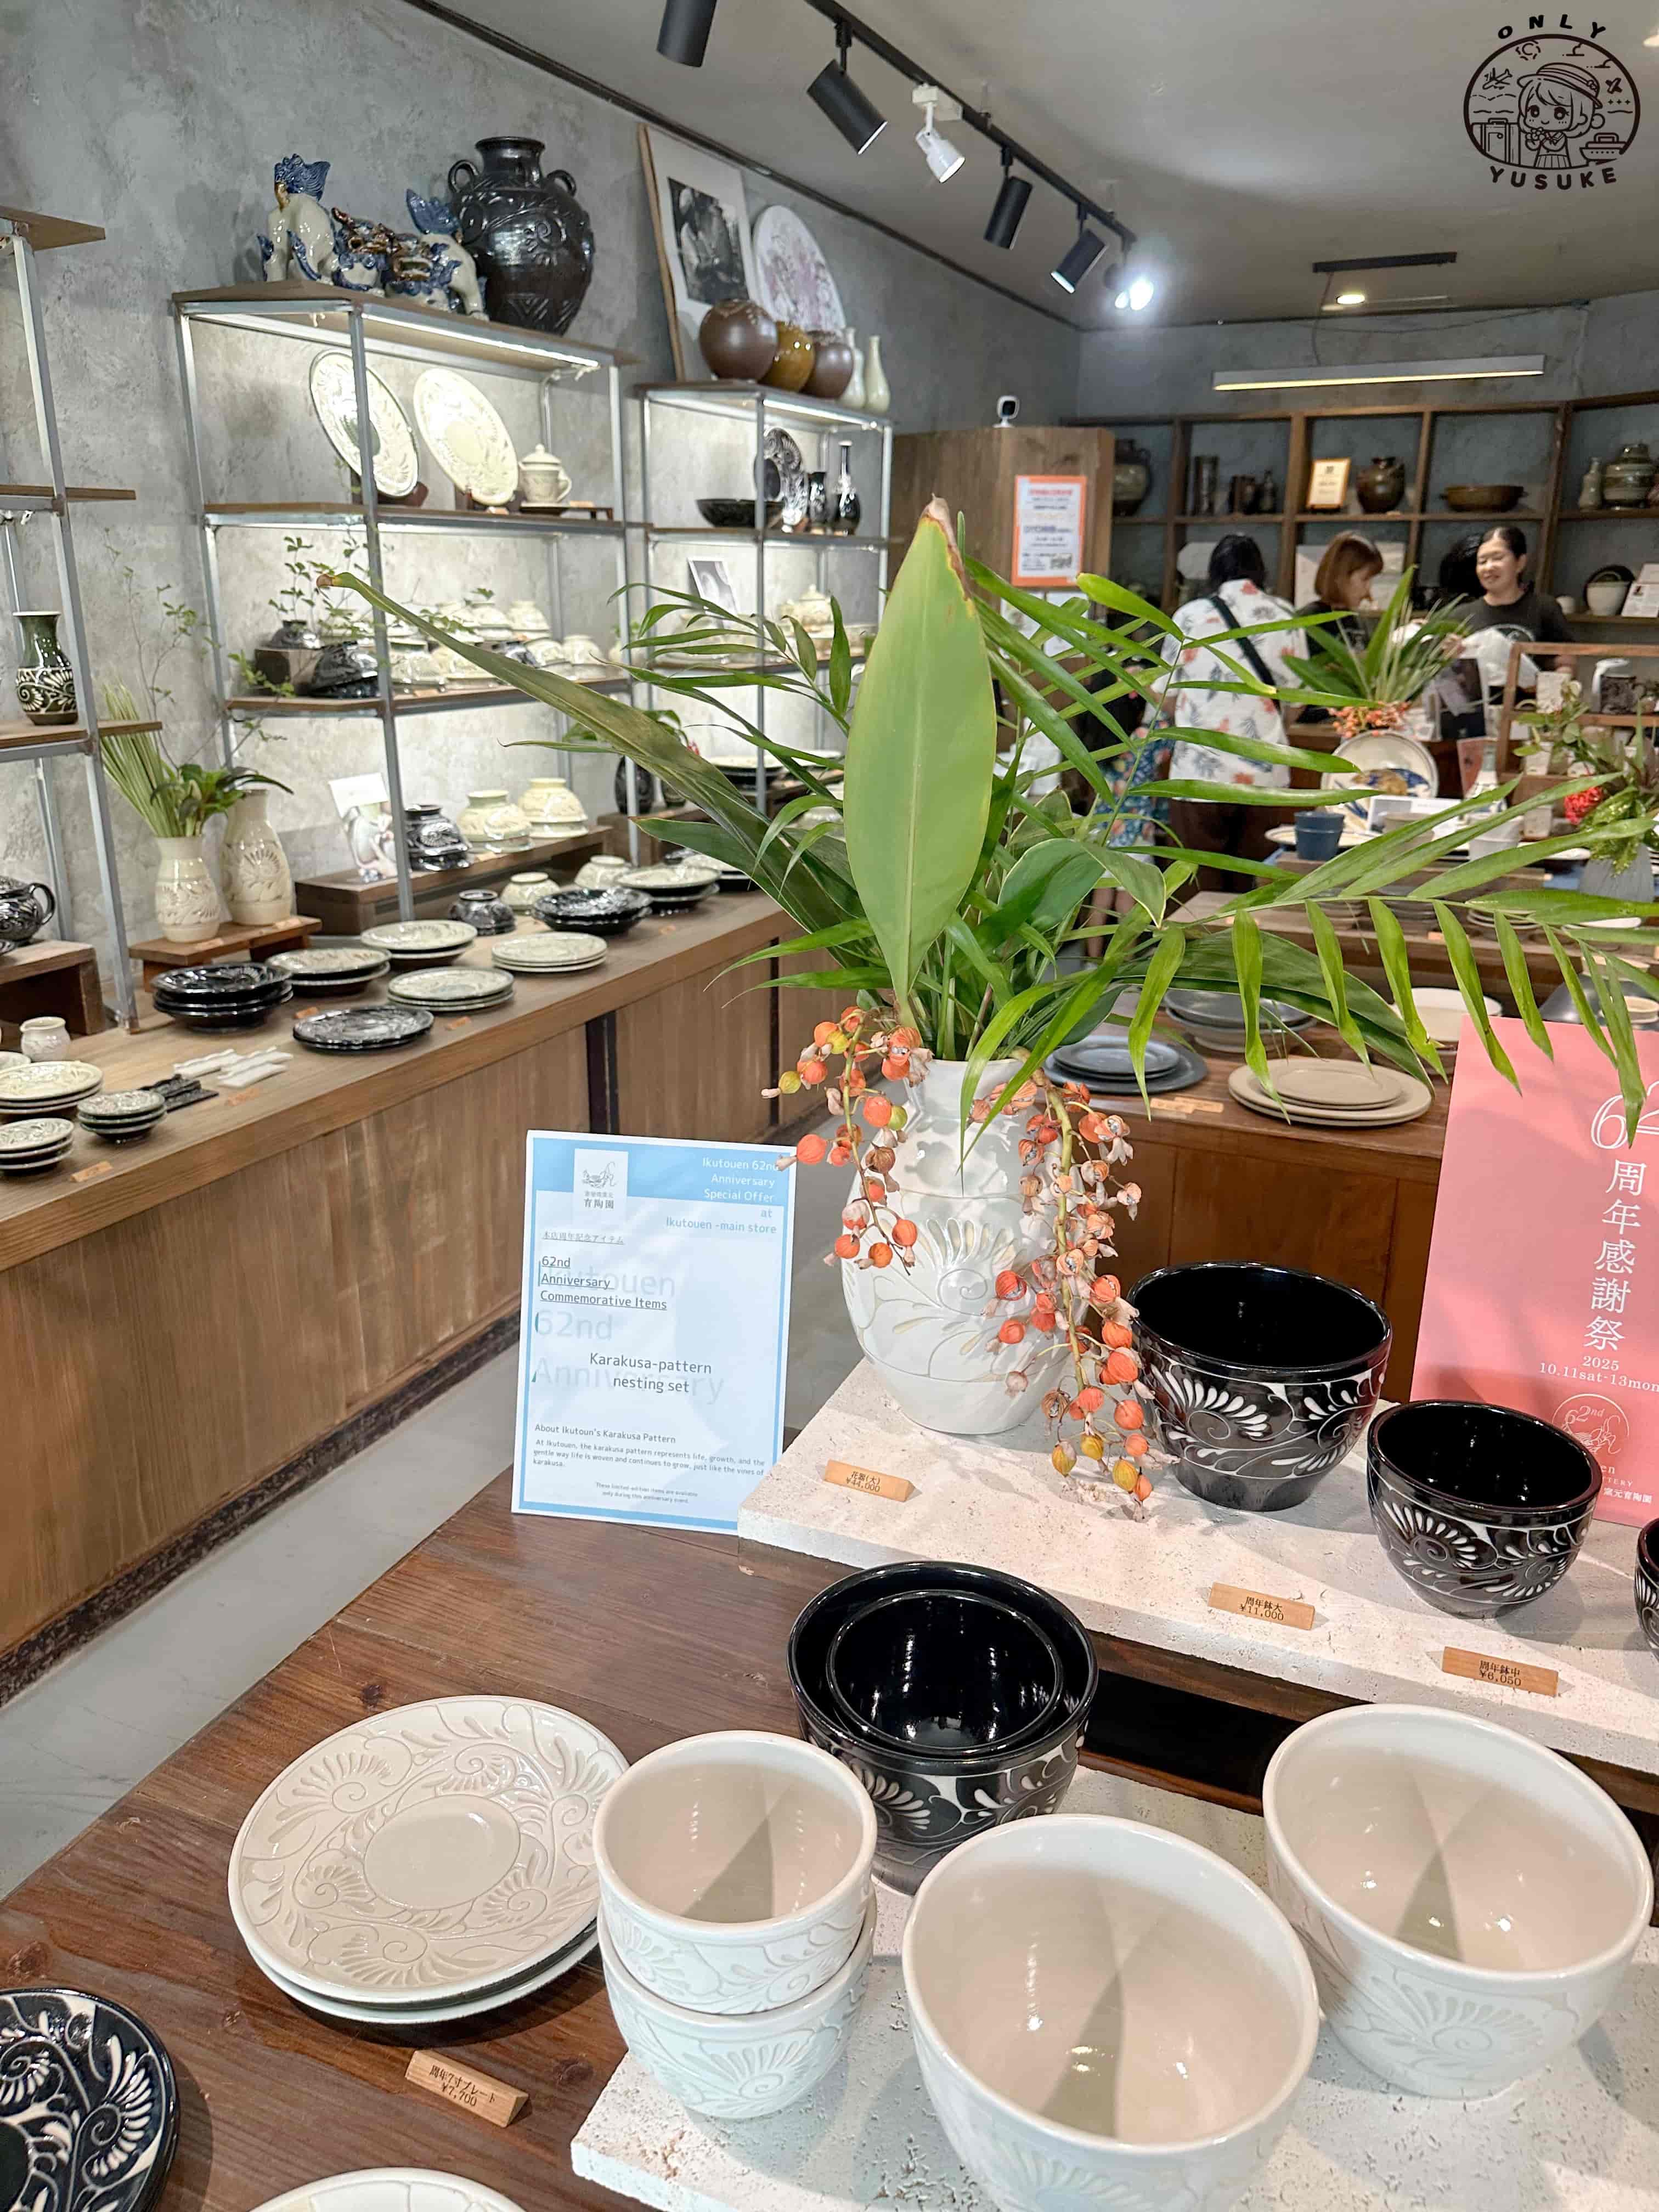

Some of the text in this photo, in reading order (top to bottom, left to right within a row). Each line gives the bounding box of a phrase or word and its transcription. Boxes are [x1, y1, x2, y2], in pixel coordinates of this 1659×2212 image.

[702, 1157, 748, 1170] Ikutouen
[711, 1173, 775, 1188] Anniversary
[704, 1188, 774, 1203] Special Offer
[760, 1209, 772, 1218] at
[666, 1216, 777, 1234] Ikutouen -main store
[541, 1256, 571, 1268] 62nd
[1583, 1159, 1647, 1352] 周年感謝祭
[541, 1273, 611, 1290] Anniversary
[540, 1290, 667, 1309] Commemorative Items
[590, 1352, 712, 1374] Karakusa-pattern
[1583, 1356, 1619, 1370] 2025
[613, 1376, 690, 1393] nesting set
[1565, 1406, 1605, 1425] 62nd
[535, 1424, 676, 1443] About Ikutoun's Karakusa Pattern
[546, 1440, 578, 1449] Ikutouen,
[593, 1444, 624, 1453] karakusa
[626, 1448, 652, 1456] pattern
[654, 1451, 691, 1459] represents
[693, 1453, 707, 1461] life,
[709, 1455, 736, 1464] growth,
[533, 1458, 565, 1467] karakusa.
[628, 1458, 661, 1466] continues
[1245, 1596, 1282, 1612] 周年鉢大
[442, 2083, 477, 2107] ¥7,700
